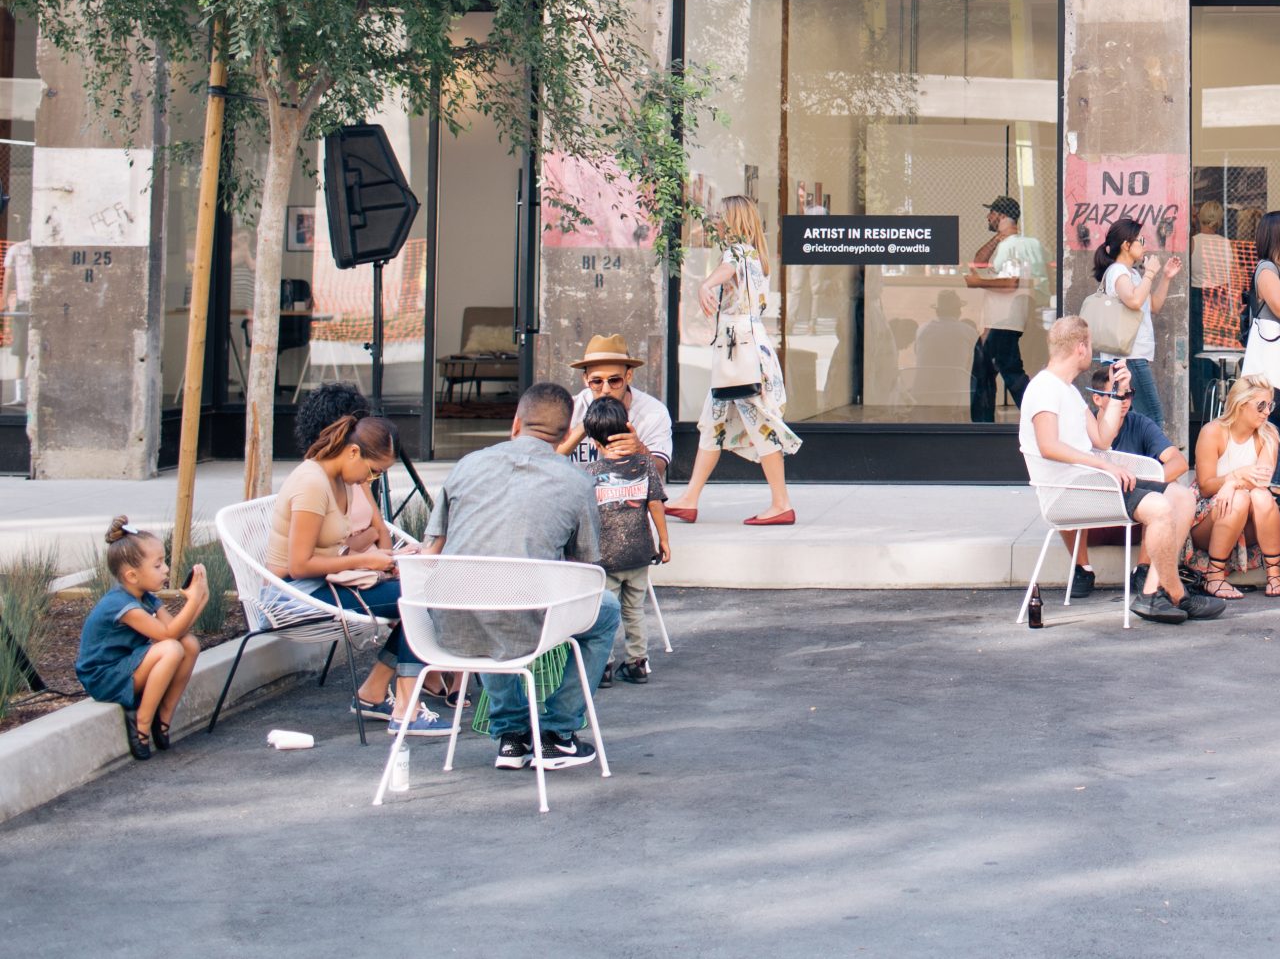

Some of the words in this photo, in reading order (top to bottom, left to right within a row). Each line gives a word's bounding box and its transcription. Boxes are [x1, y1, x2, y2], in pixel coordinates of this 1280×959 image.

[1102, 171, 1150, 196] NO
[1071, 203, 1179, 226] PARKING
[804, 228, 846, 239] ARTIST
[848, 228, 861, 239] IN
[864, 228, 932, 239] RESIDENCE
[803, 243, 886, 255] @rickrodneyphoto
[888, 243, 930, 254] @rowdtla
[93, 250, 112, 266] 25
[602, 255, 621, 270] 24
[570, 442, 599, 463] NEW
